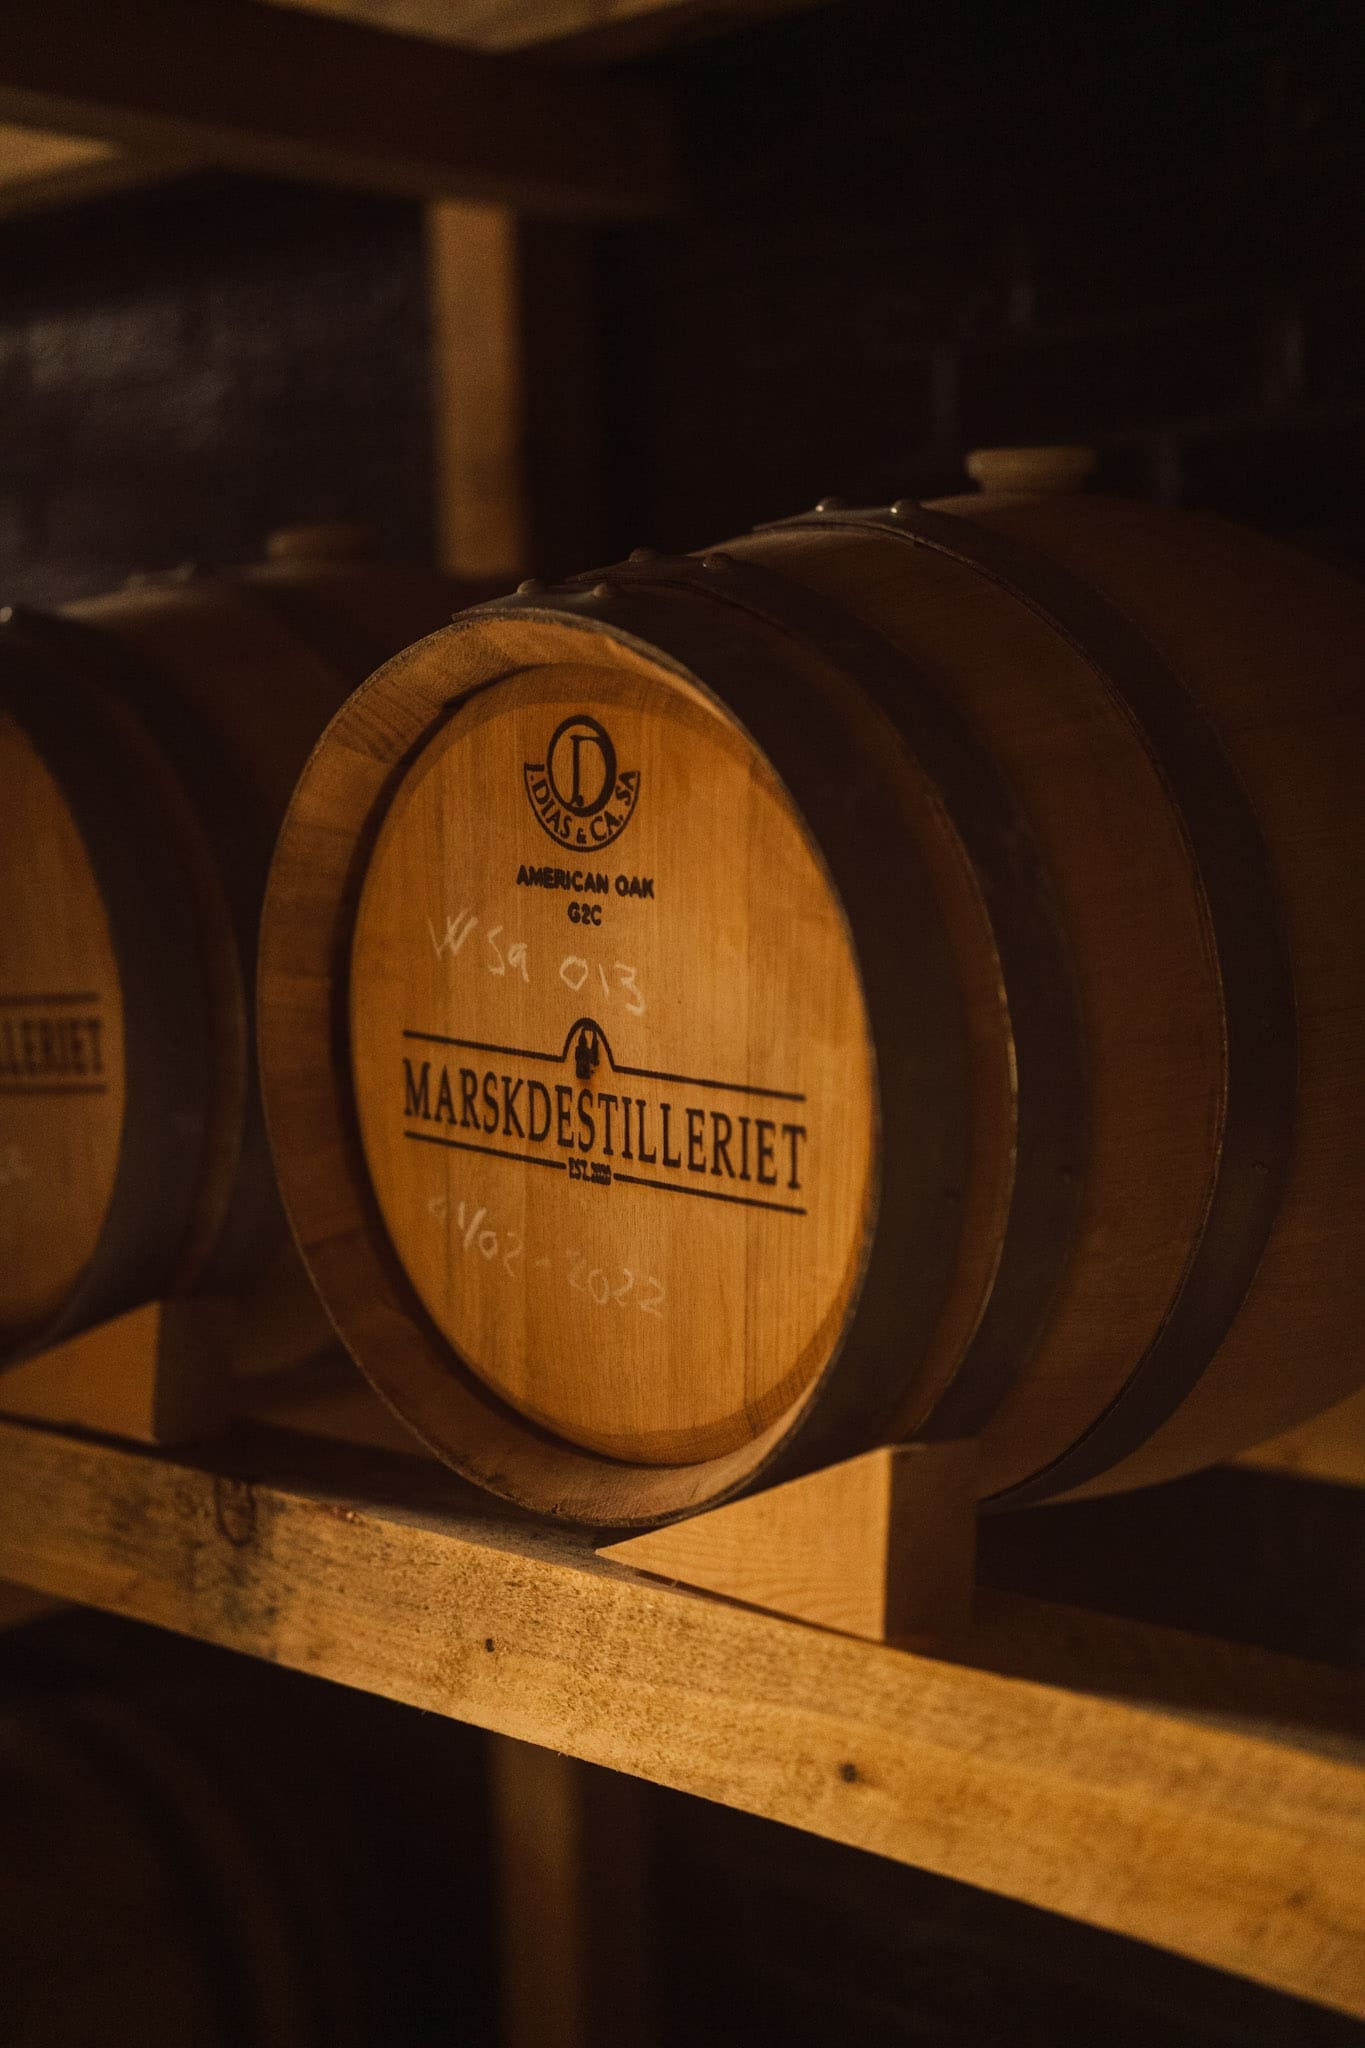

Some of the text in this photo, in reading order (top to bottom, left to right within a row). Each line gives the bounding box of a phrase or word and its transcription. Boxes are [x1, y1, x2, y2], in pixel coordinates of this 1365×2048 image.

[576, 828, 587, 844] &
[516, 864, 655, 899] AMERICAN OAK
[567, 902, 602, 925] G2C
[402, 1058, 807, 1189] MARSKDESTILLERIET
